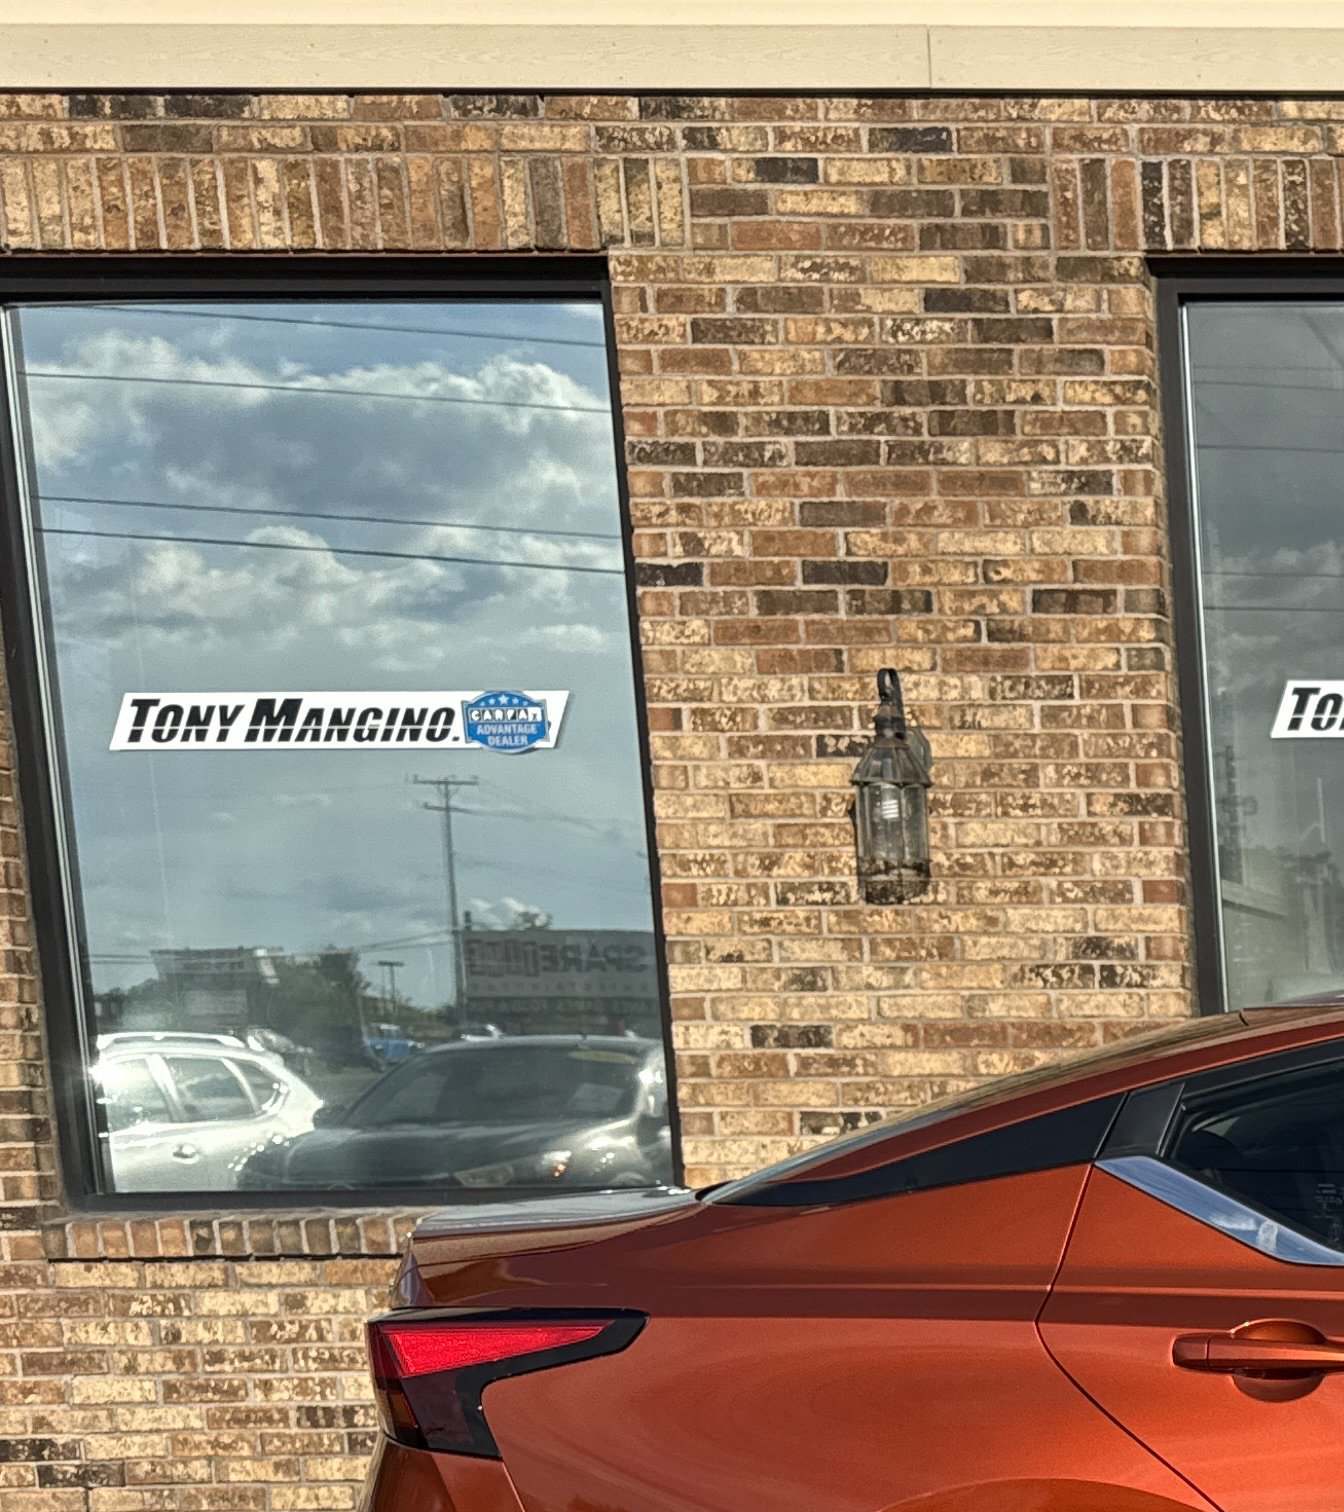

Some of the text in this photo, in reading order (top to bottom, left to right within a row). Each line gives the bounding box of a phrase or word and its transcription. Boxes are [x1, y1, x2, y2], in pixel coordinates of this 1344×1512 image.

[127, 698, 245, 743] TONY
[470, 707, 543, 722] CARFAX
[476, 724, 538, 735] ADVANTAGE
[487, 735, 529, 746] DEALER
